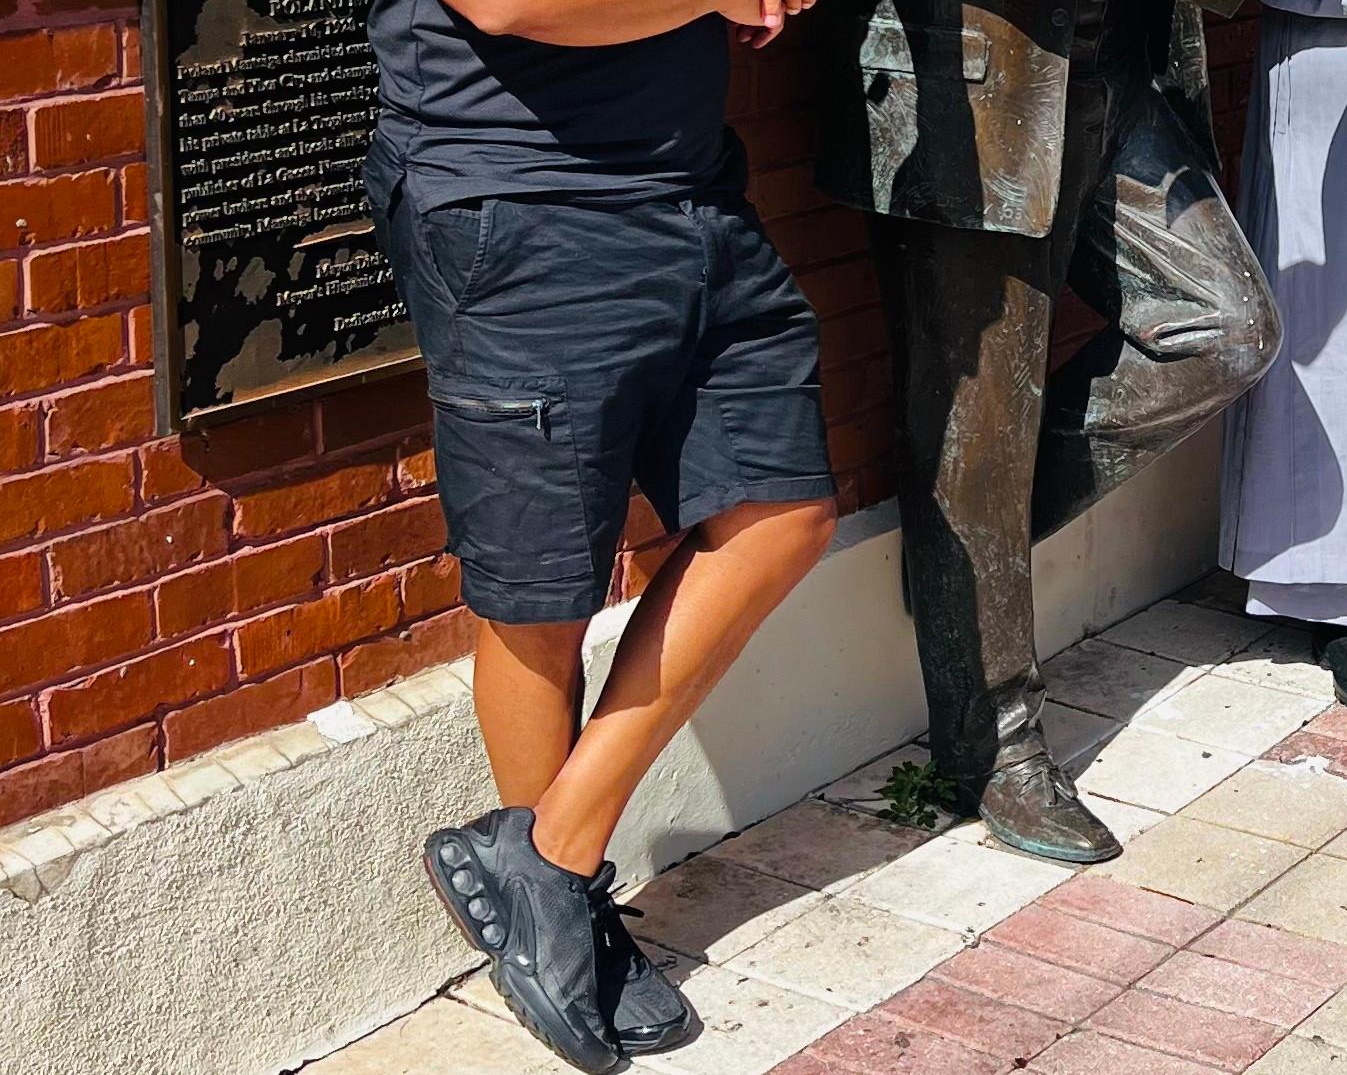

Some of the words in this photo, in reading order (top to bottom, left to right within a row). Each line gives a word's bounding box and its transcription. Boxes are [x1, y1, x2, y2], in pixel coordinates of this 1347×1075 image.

[306, 67, 330, 83] and
[178, 113, 206, 127] than
[201, 131, 246, 151] private
[180, 158, 209, 174] with
[210, 149, 273, 174] presidents
[274, 142, 297, 159] and
[298, 137, 334, 155] locals
[180, 179, 239, 203] publisher
